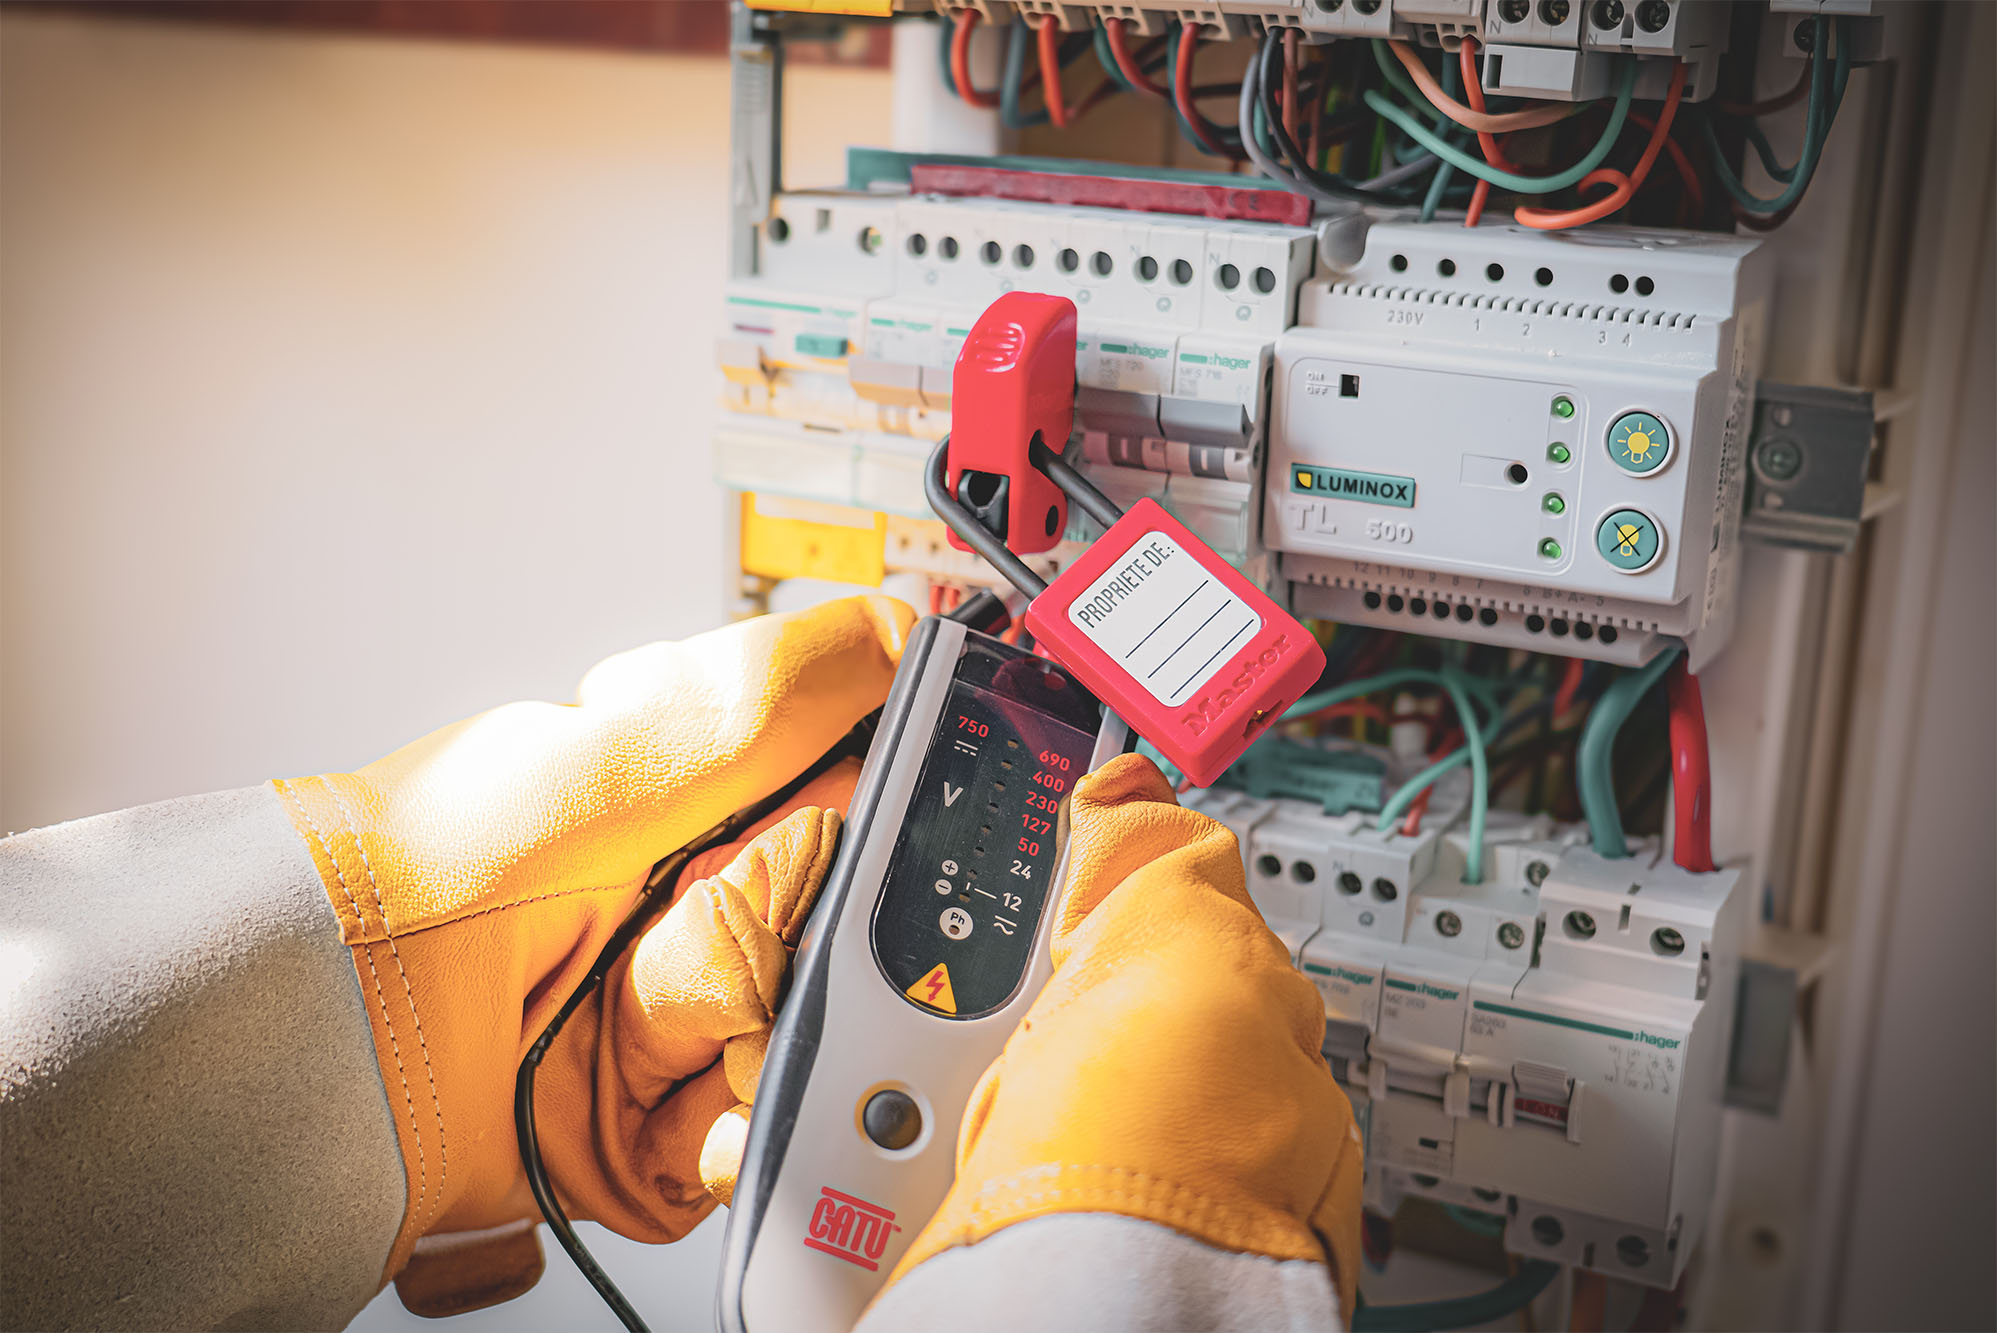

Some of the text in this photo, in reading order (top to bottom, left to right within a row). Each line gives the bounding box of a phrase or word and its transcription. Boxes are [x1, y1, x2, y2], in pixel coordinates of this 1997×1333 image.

[1489, 20, 1500, 34] N
[1588, 33, 1598, 46] N
[1387, 309, 1424, 325] 230V
[1474, 318, 1481, 332] 1
[1522, 323, 1531, 336] 2
[1598, 331, 1632, 347] 3 4
[1316, 474, 1408, 501] LUMINOX
[1290, 504, 1413, 545] TL 500
[1077, 542, 1175, 629] PROPRIETE DE:
[1353, 562, 1369, 574] 12
[1376, 564, 1391, 576] 11
[1400, 567, 1415, 580] 10
[1429, 571, 1437, 583] 9
[1475, 578, 1483, 590] 7
[1182, 634, 1293, 738] Master
[958, 716, 989, 738] 750
[1039, 749, 1071, 772] 690
[1032, 772, 1065, 794] 400
[943, 782, 964, 808] V
[1025, 792, 1059, 816] 230
[1021, 813, 1052, 836] 127
[1017, 837, 1041, 857] 50
[1010, 860, 1032, 880] 24
[1003, 892, 1023, 912] 12
[950, 911, 966, 926] Ph
[809, 1197, 893, 1260] CATU
